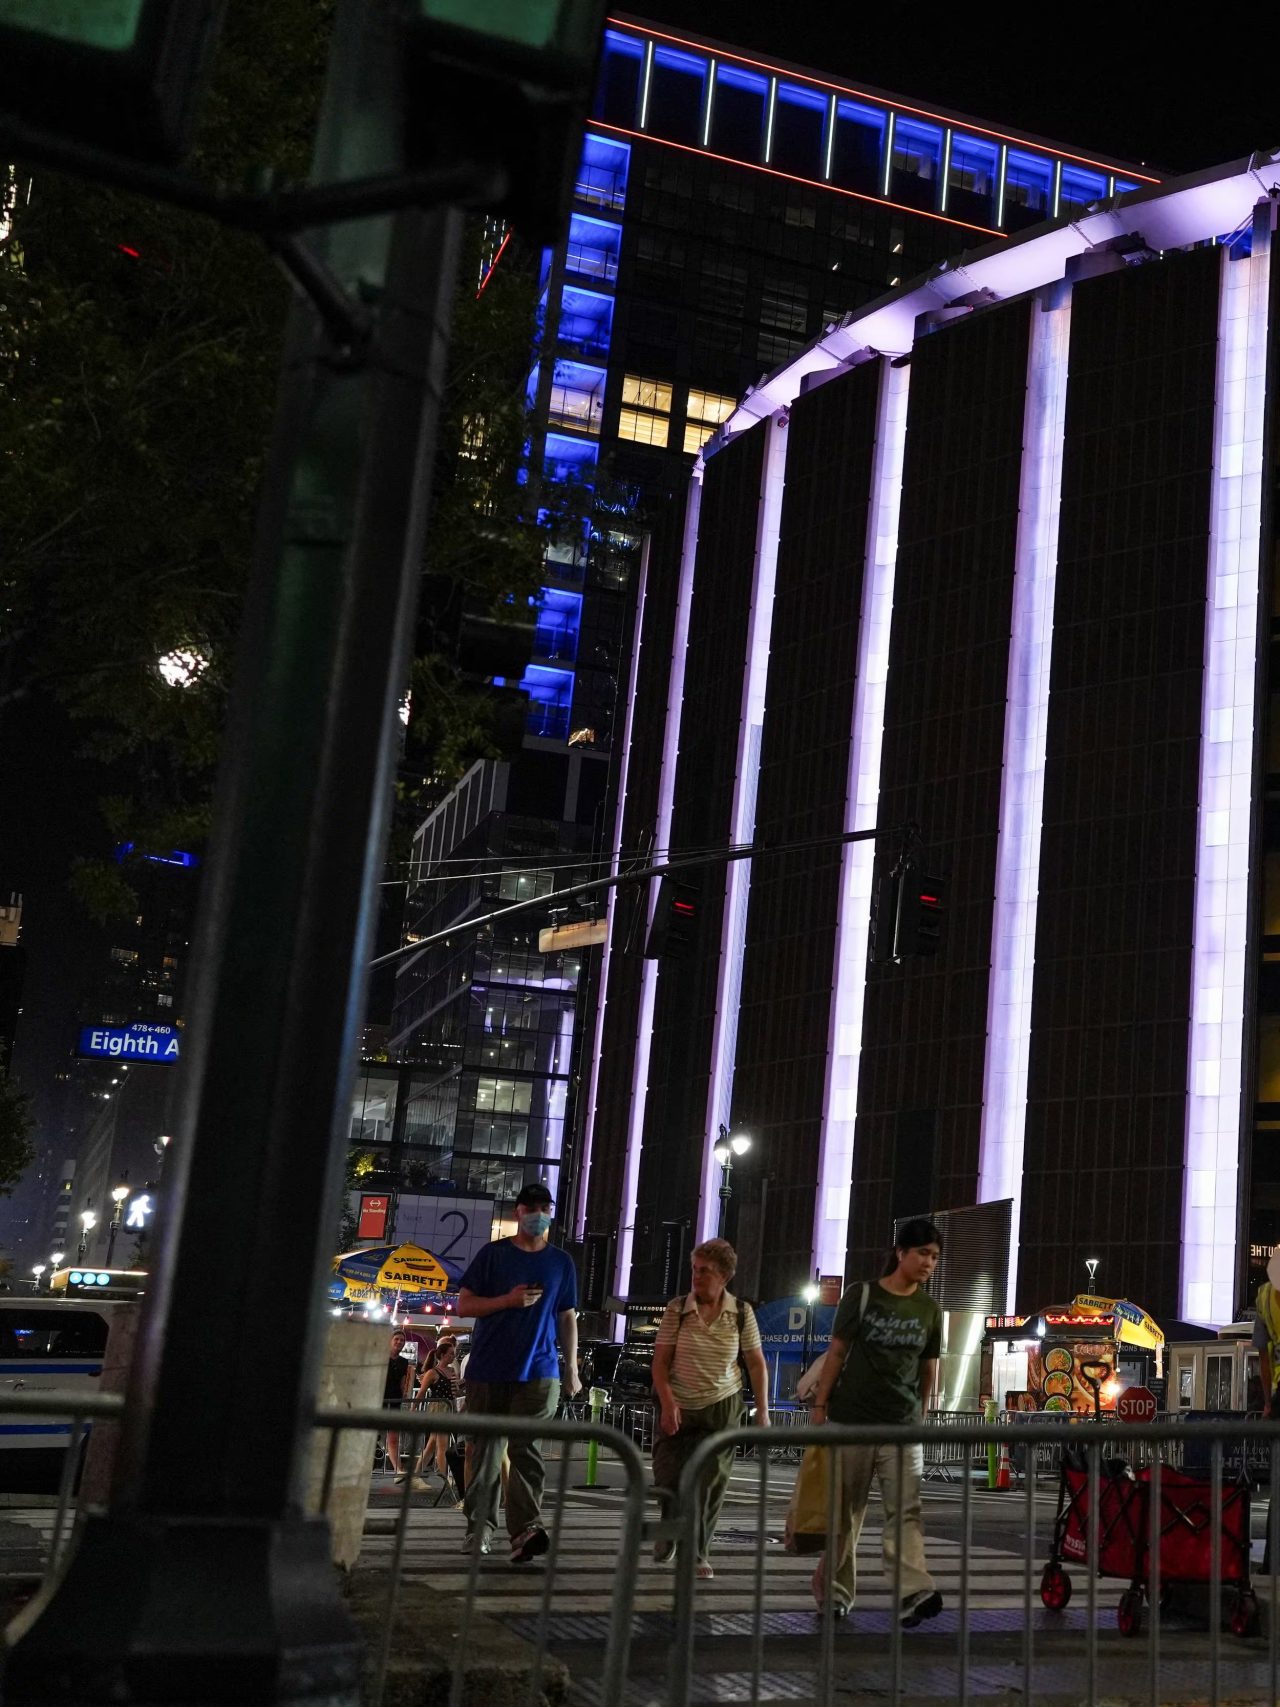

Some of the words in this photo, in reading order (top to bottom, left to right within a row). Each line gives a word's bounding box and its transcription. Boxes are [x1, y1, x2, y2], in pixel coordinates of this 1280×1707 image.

[132, 1024, 147, 1032] 478
[90, 1031, 159, 1056] Eighth
[384, 1271, 445, 1287] SABRETT
[1079, 1298, 1115, 1312] SABRETT
[788, 1307, 807, 1330] D
[1120, 1400, 1155, 1416] STOP
